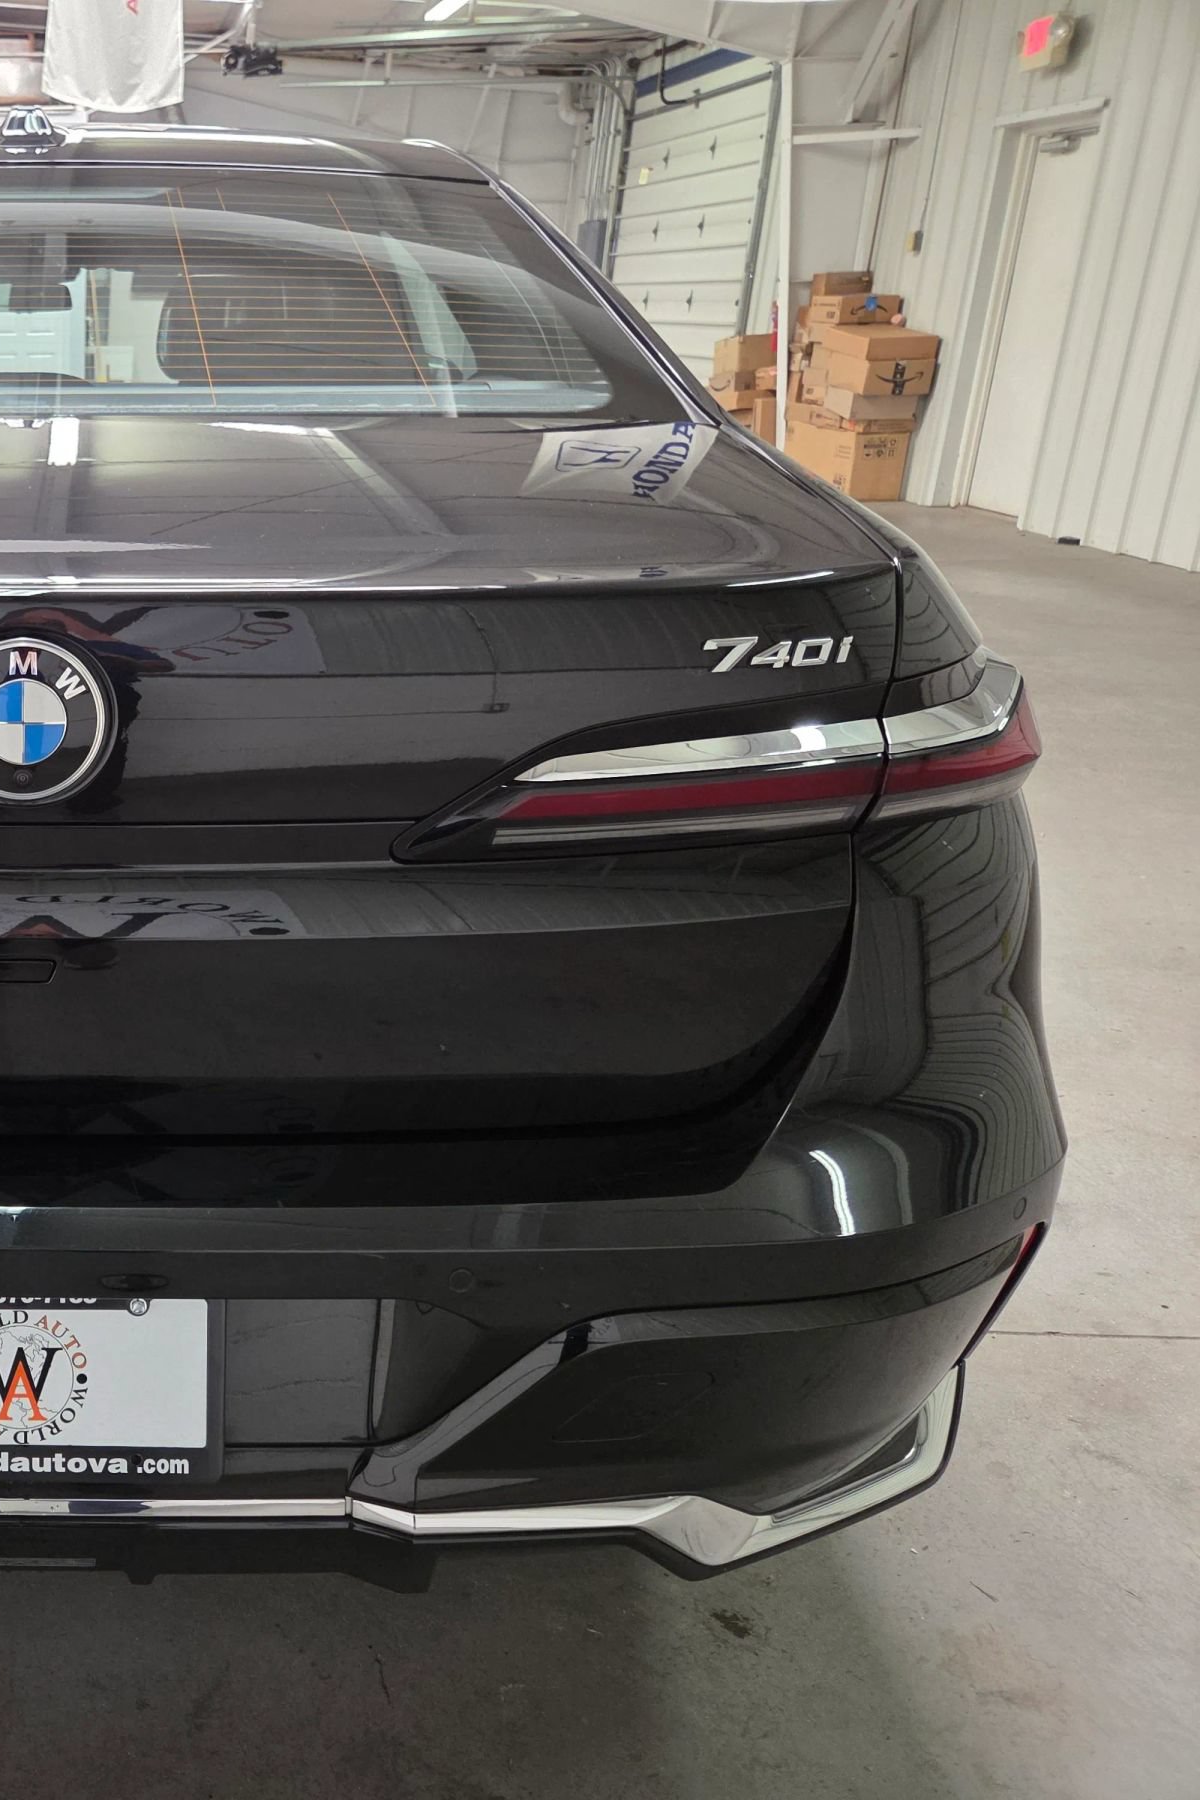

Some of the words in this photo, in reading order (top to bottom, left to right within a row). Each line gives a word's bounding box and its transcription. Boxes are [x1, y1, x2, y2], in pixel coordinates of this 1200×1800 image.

[703, 635, 854, 673] 740i
[34, 1314, 87, 1369] AUTO
[13, 1387, 89, 1445] WORLD
